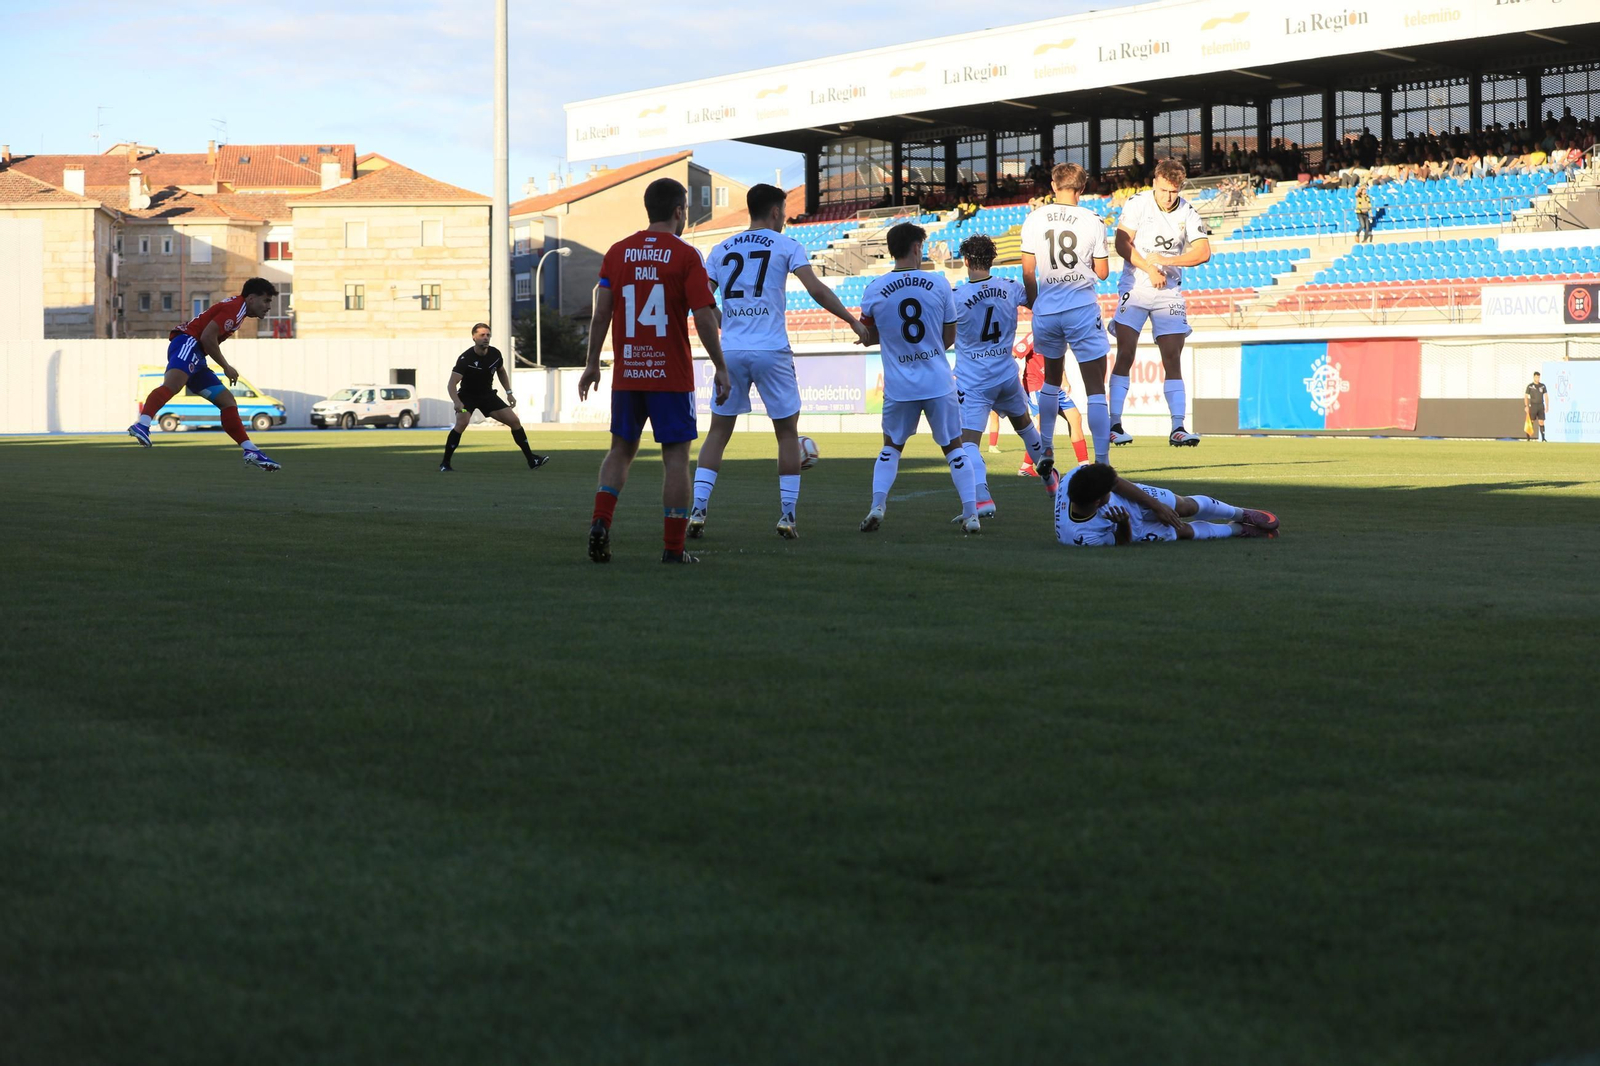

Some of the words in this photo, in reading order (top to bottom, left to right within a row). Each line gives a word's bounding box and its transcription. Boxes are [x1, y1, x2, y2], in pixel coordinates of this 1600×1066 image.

[1285, 18, 1307, 35] La
[1098, 46, 1117, 62] La
[943, 69, 961, 85] La
[810, 90, 825, 105] La
[686, 110, 700, 125] La
[576, 128, 588, 142] La
[723, 242, 734, 251] E.
[734, 233, 775, 248] MATEOS
[1045, 229, 1079, 270] 18
[624, 248, 672, 264] POVARELO
[635, 264, 660, 280] RAÚL
[722, 250, 771, 300] 27
[880, 276, 935, 298] HUIDOBRO
[964, 287, 1008, 310] MAROTIAS
[1121, 292, 1131, 306] 9
[622, 283, 669, 338] 14
[898, 297, 926, 344] 8
[980, 305, 1002, 344] 4
